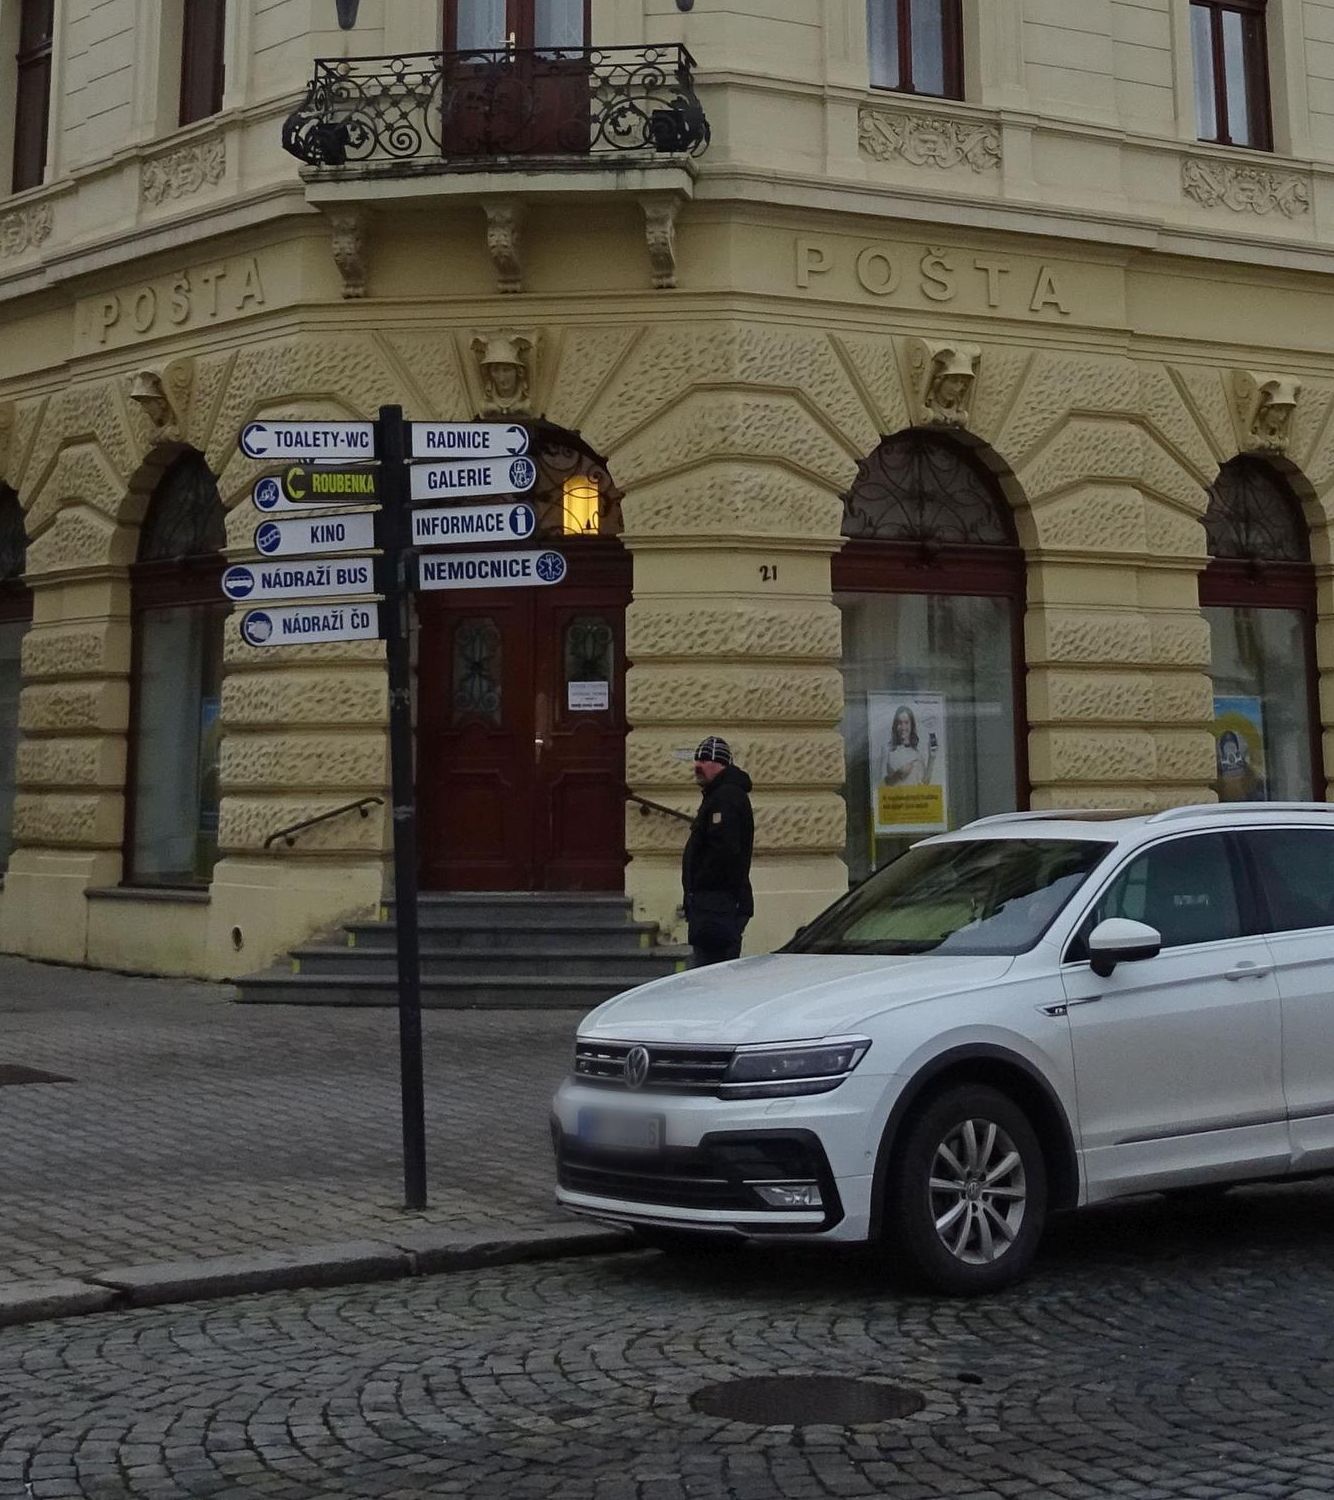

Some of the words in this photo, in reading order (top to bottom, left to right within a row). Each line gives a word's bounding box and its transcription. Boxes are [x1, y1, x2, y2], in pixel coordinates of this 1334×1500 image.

[795, 237, 1071, 314] POŠTA
[96, 257, 266, 345] POŠTA
[274, 430, 370, 449] TOALETY-WC
[426, 430, 491, 450] RADNICE
[312, 472, 376, 495] ROUBENKA
[427, 467, 493, 490] GALERIE
[310, 523, 346, 544] KINO
[416, 513, 505, 536] INFORMACE
[261, 565, 332, 590] NÁDRAŽÍ
[336, 567, 368, 585] BUS
[423, 558, 532, 582] NEMOCNICE
[282, 610, 344, 634] NÁDRAŽÍ
[351, 608, 370, 631] ČD
